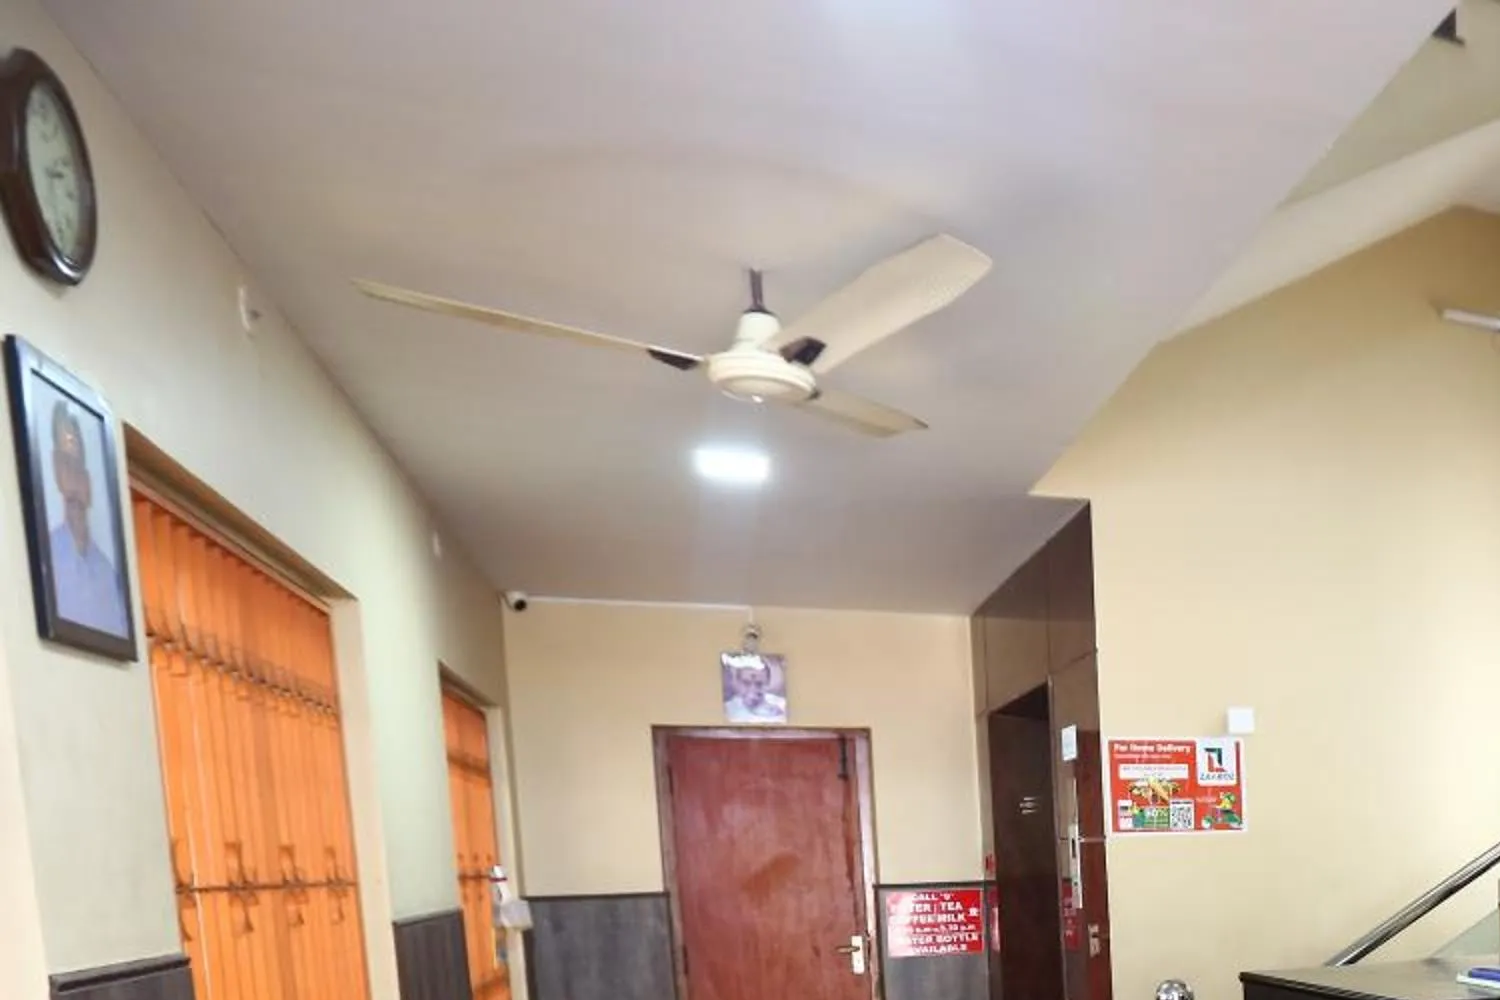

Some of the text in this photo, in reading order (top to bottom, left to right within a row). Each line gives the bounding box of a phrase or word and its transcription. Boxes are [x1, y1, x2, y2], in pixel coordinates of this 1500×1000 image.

[1113, 743, 1191, 754] For Home Delivery
[941, 901, 963, 911] TEA
